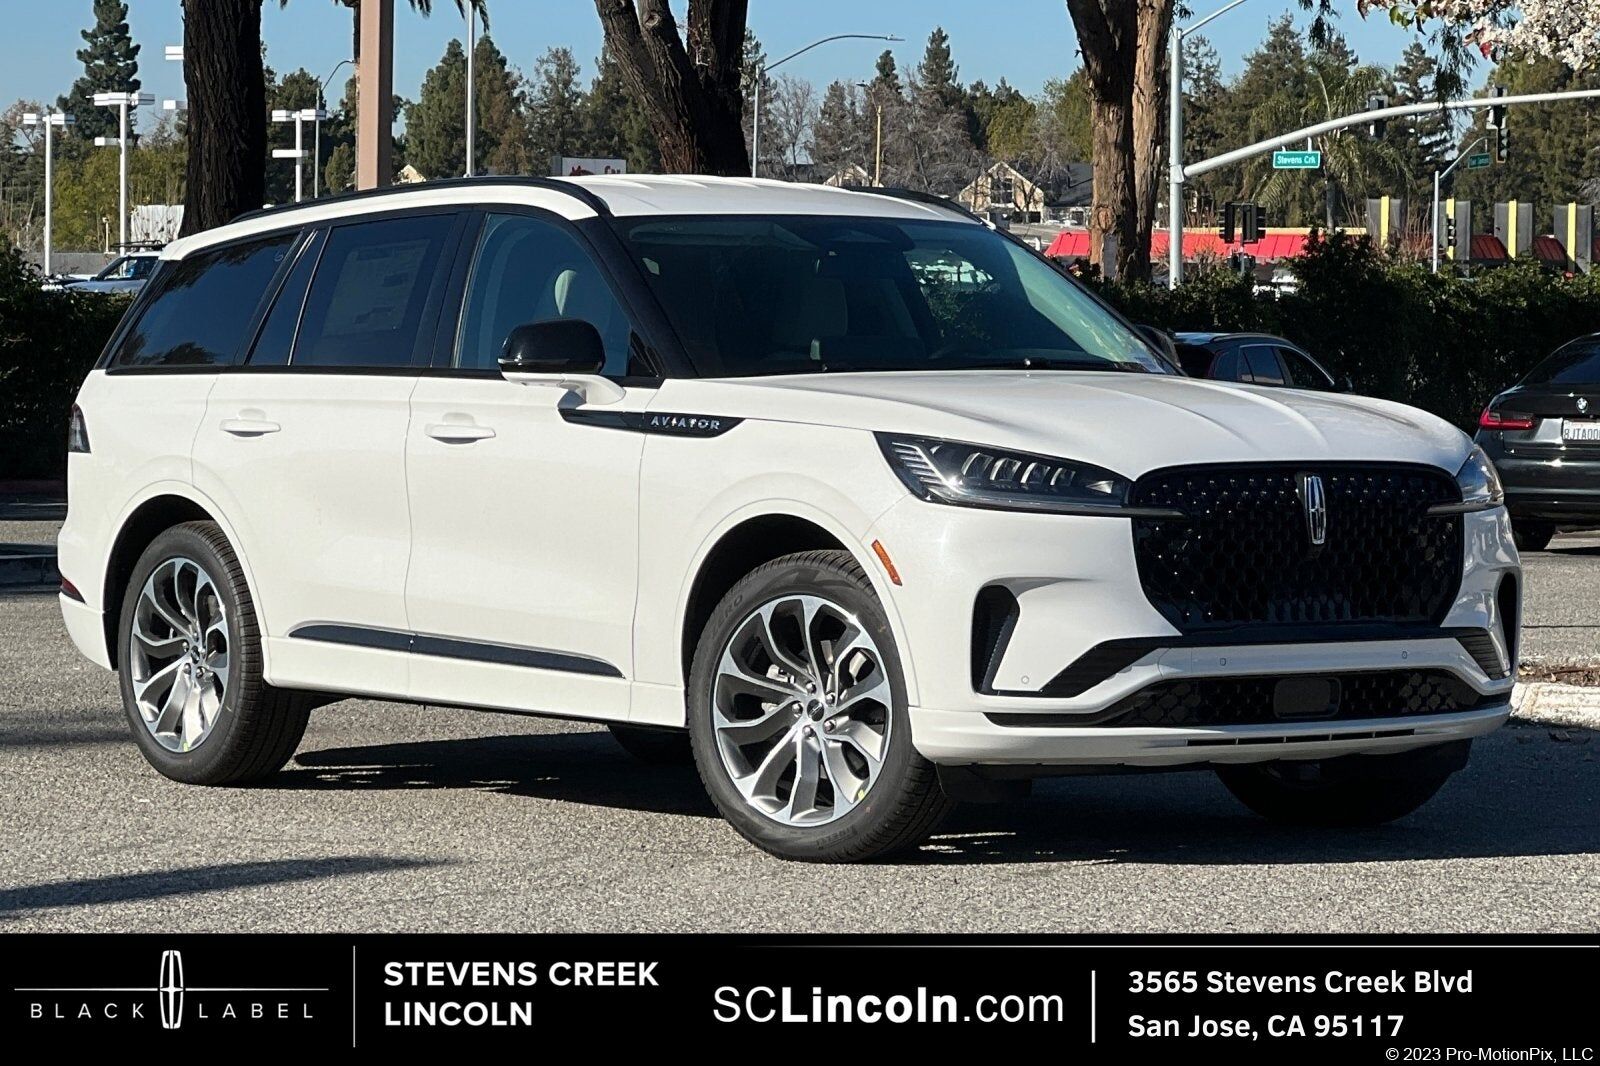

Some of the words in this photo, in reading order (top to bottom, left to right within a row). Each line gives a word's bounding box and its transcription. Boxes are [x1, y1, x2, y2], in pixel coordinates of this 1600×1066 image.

[1277, 155, 1302, 164] Stevens
[1304, 155, 1316, 164] Crk
[650, 416, 720, 429] AVIATOR
[1564, 428, 1600, 440] 8JTA00
